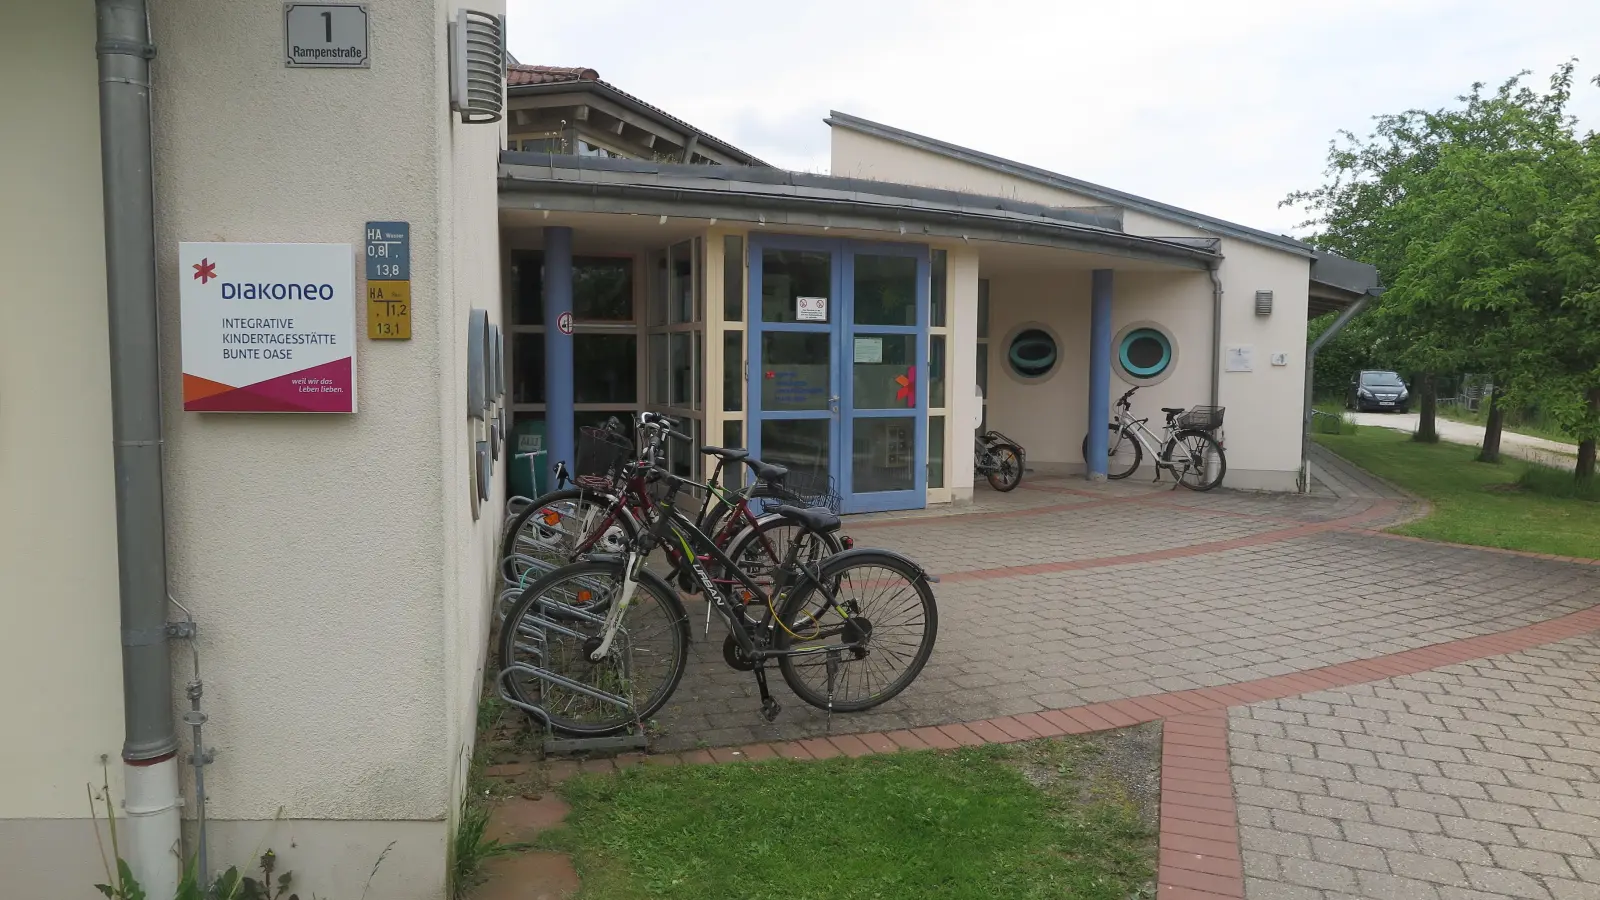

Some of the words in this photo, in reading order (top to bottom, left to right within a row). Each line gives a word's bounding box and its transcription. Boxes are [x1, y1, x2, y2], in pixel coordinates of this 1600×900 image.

[320, 11, 332, 43] 1
[293, 46, 362, 60] Rampenstraße
[367, 228, 383, 240] HA
[376, 264, 400, 277] 13,8
[369, 287, 384, 299] HA
[222, 318, 294, 329] INTEGRATIVE
[377, 323, 400, 336] 13,1
[222, 332, 336, 345] KINDERTAGESSTÄTTE
[223, 348, 260, 359] BUNTE
[263, 349, 293, 359] OASE
[291, 377, 307, 385] weil
[299, 385, 320, 393] Leben
[320, 385, 344, 393] lieben.
[692, 564, 725, 606] URBAN
